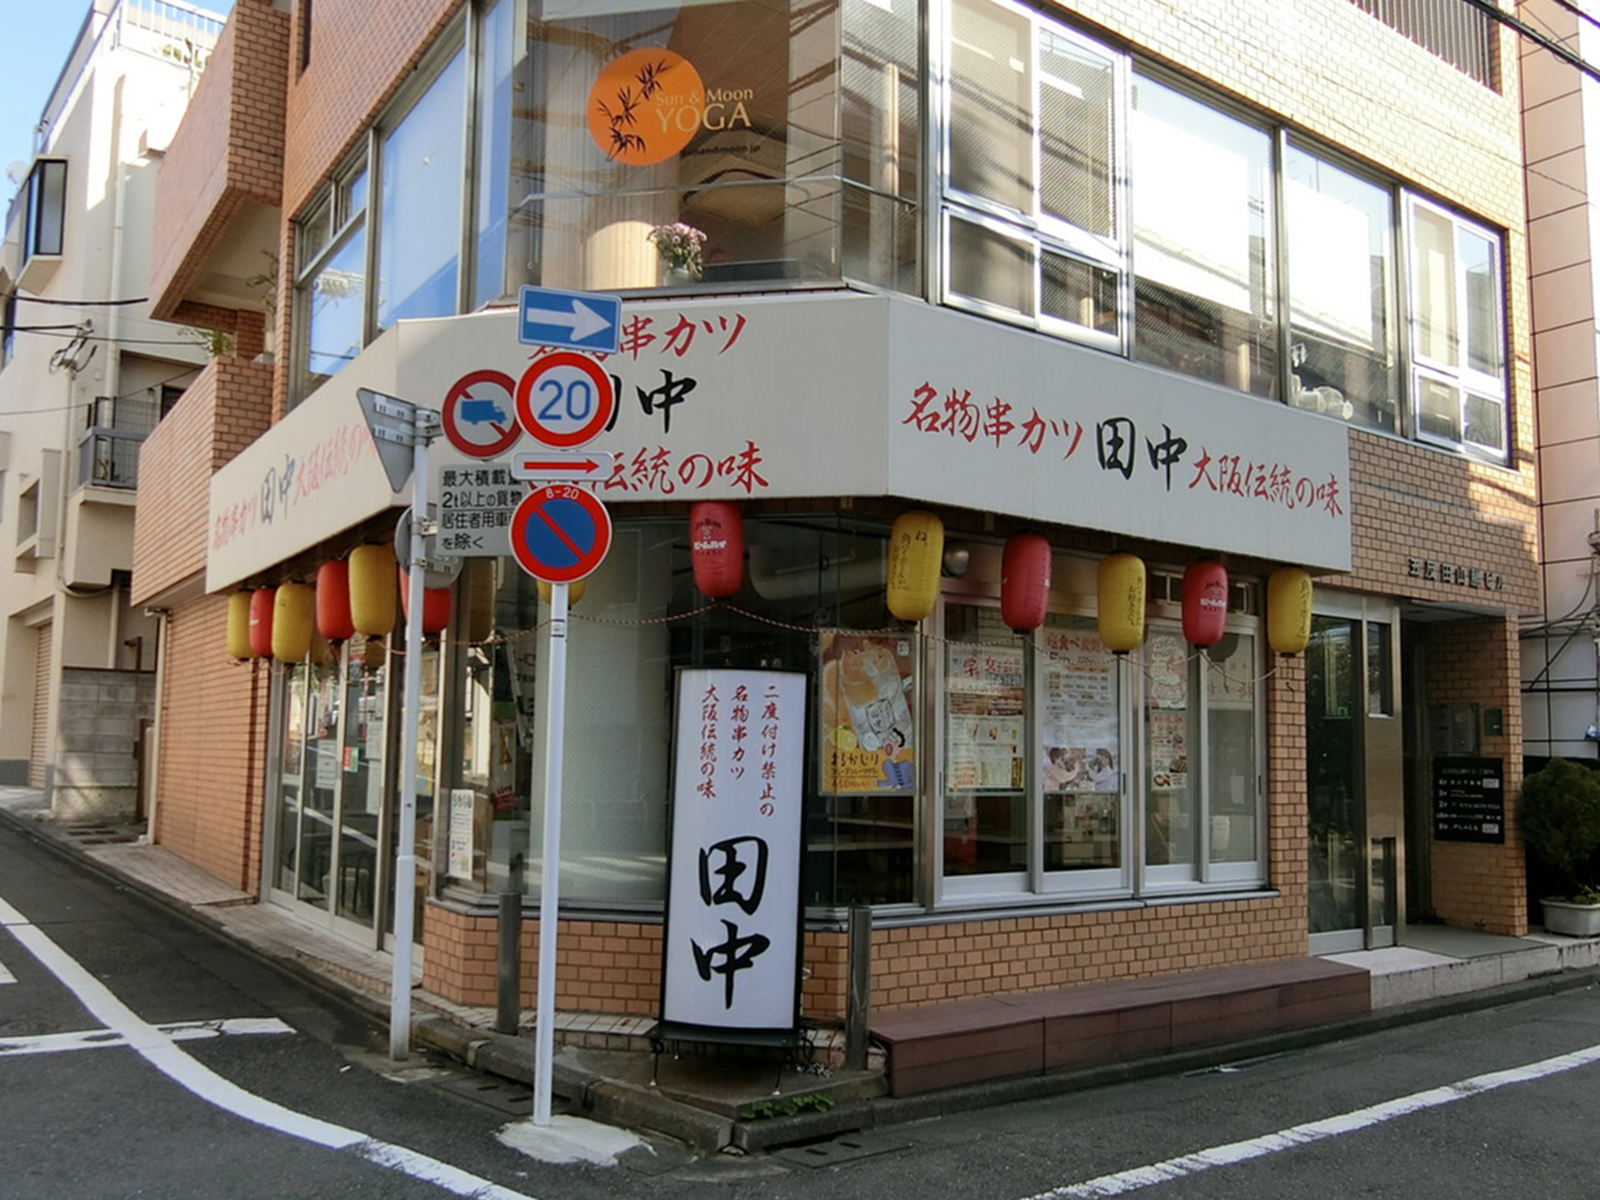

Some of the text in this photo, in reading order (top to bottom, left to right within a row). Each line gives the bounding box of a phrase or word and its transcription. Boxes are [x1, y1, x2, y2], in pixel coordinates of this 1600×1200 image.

[655, 101, 752, 134] YOGA
[656, 92, 683, 107] Sun
[706, 88, 754, 103] Moon
[538, 379, 592, 421] 20
[605, 369, 697, 434] 中
[902, 381, 1343, 519] 名物串カツ 田中 大阪伝統の味
[260, 453, 296, 526] 田中
[441, 510, 513, 529] 居住者用車
[545, 487, 580, 500] 8-20
[441, 533, 485, 550] を除く
[696, 684, 720, 800] 大阪伝統の味
[730, 684, 750, 780] 名物串カツ
[759, 684, 780, 818] 二度付け禁止の
[690, 835, 771, 1011] 田中
